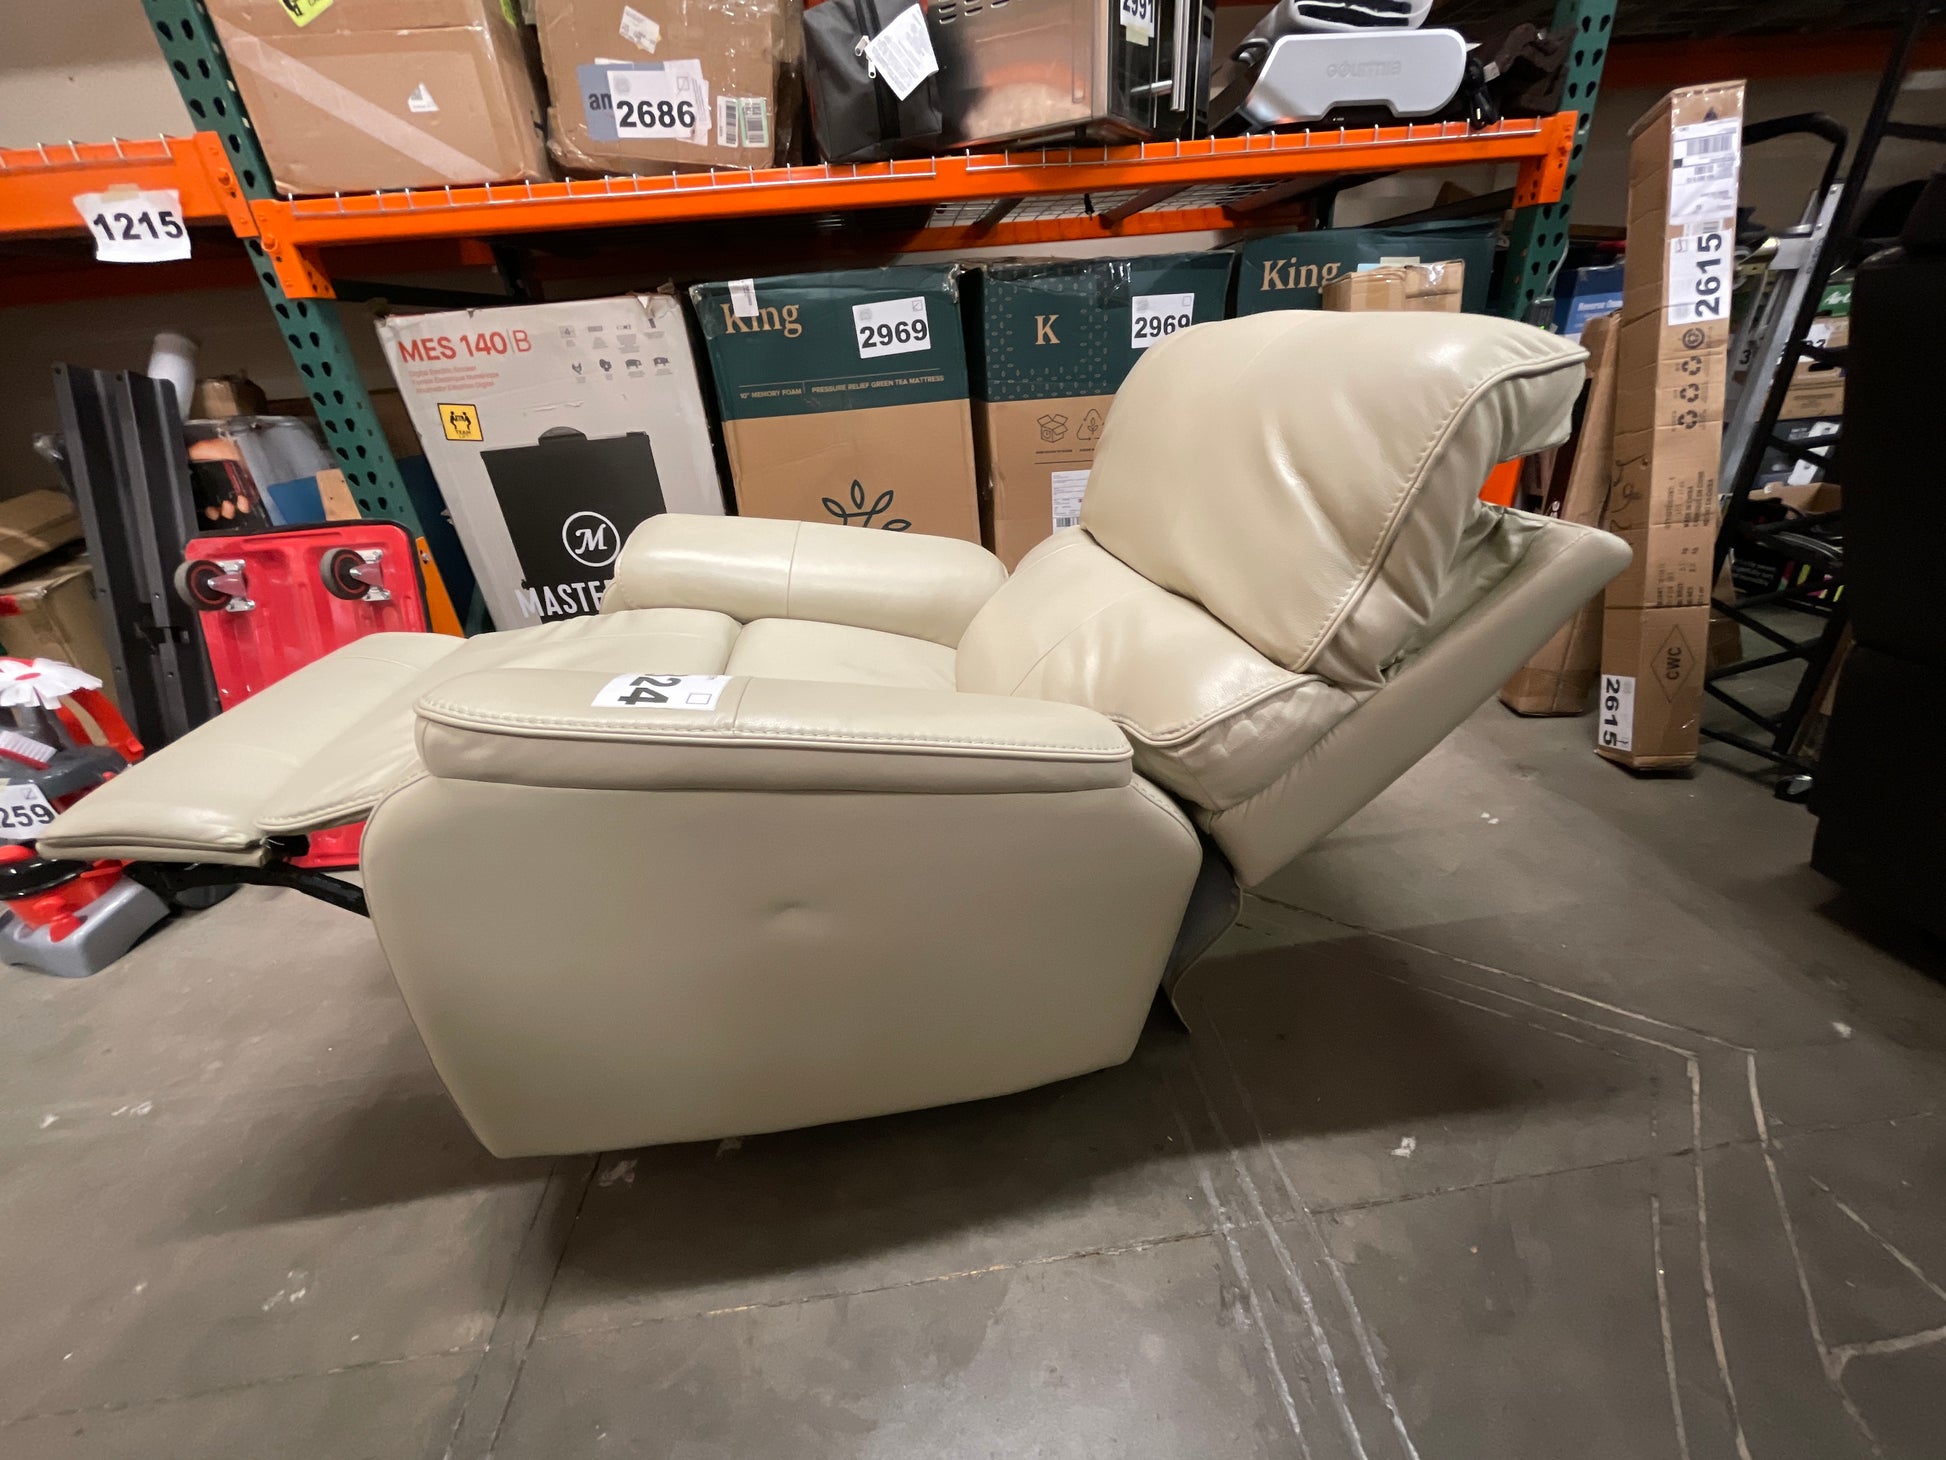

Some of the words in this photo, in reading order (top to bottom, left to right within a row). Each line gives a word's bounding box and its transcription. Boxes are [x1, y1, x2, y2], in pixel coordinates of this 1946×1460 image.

[616, 100, 695, 128] 2686
[93, 211, 183, 240] 1215
[1695, 233, 1722, 317] 2615
[860, 319, 928, 349] 2969
[1034, 314, 1061, 345] K
[1134, 313, 1191, 338] 2969
[398, 336, 457, 363] MES
[751, 389, 780, 398] MEMORY
[782, 388, 802, 396] FOAM
[811, 384, 848, 393] PRESSURE
[848, 382, 869, 391] RELIEF
[871, 379, 894, 388] GREEN
[895, 378, 908, 386] TEA
[909, 375, 945, 384] MATTRESS
[575, 524, 608, 555] M
[514, 579, 616, 618] MASTE
[1665, 647, 1682, 680] CWC
[1603, 678, 1620, 747] 2615
